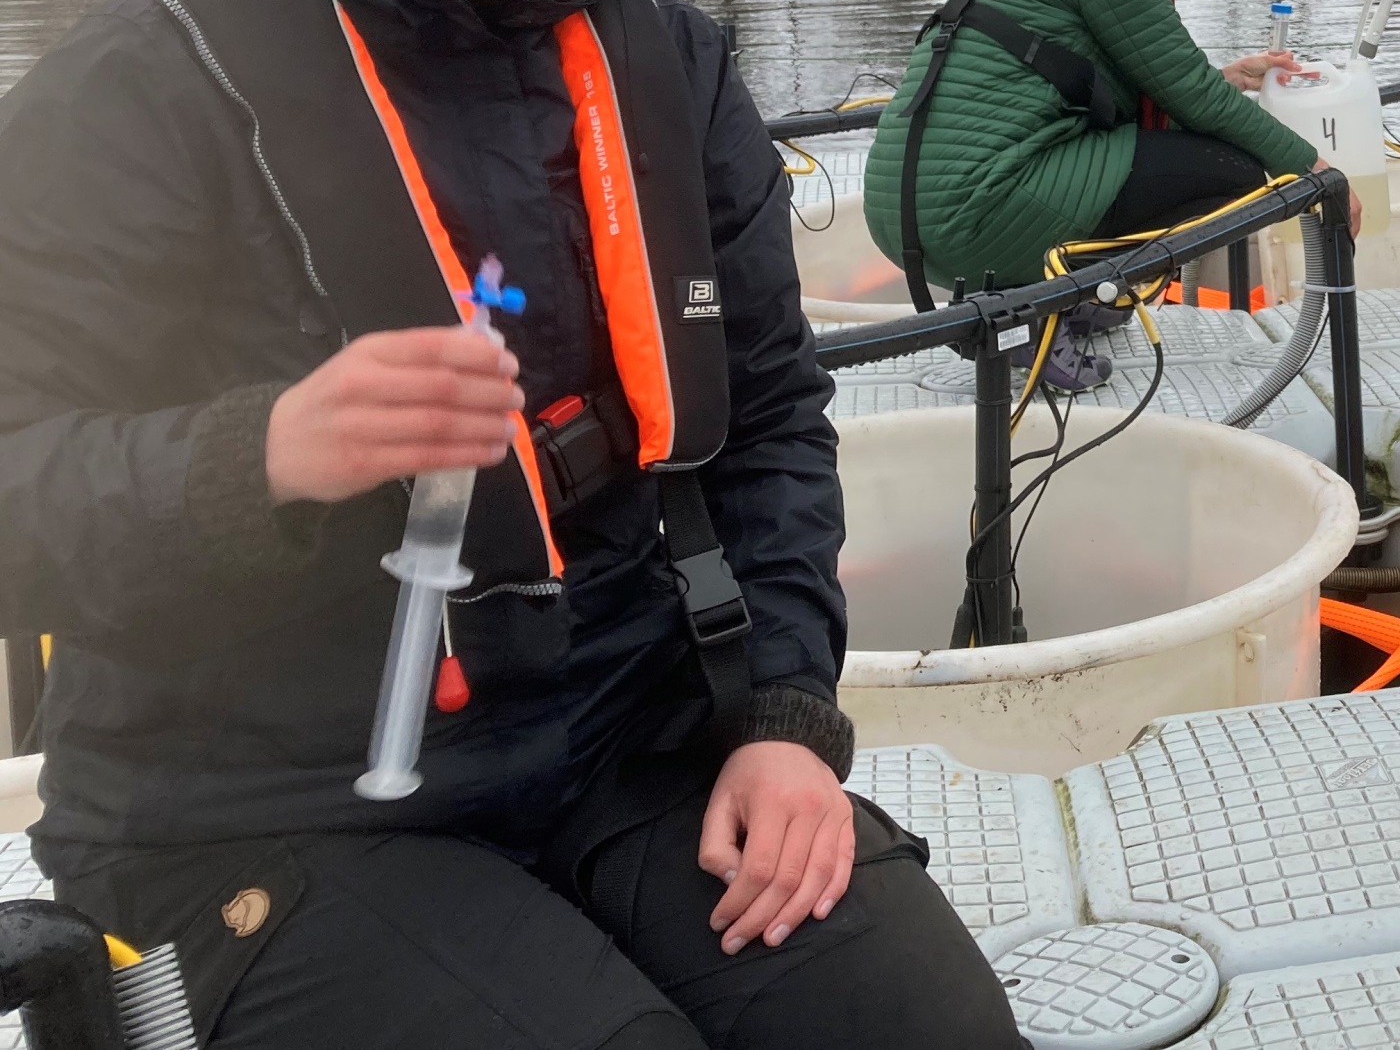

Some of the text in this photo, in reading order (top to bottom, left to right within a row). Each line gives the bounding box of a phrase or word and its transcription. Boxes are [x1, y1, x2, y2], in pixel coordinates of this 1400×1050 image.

[588, 105, 609, 172] WINNER
[1322, 118, 1336, 151] 4
[601, 175, 620, 236] BALTIC
[683, 305, 721, 315] BALTIC
